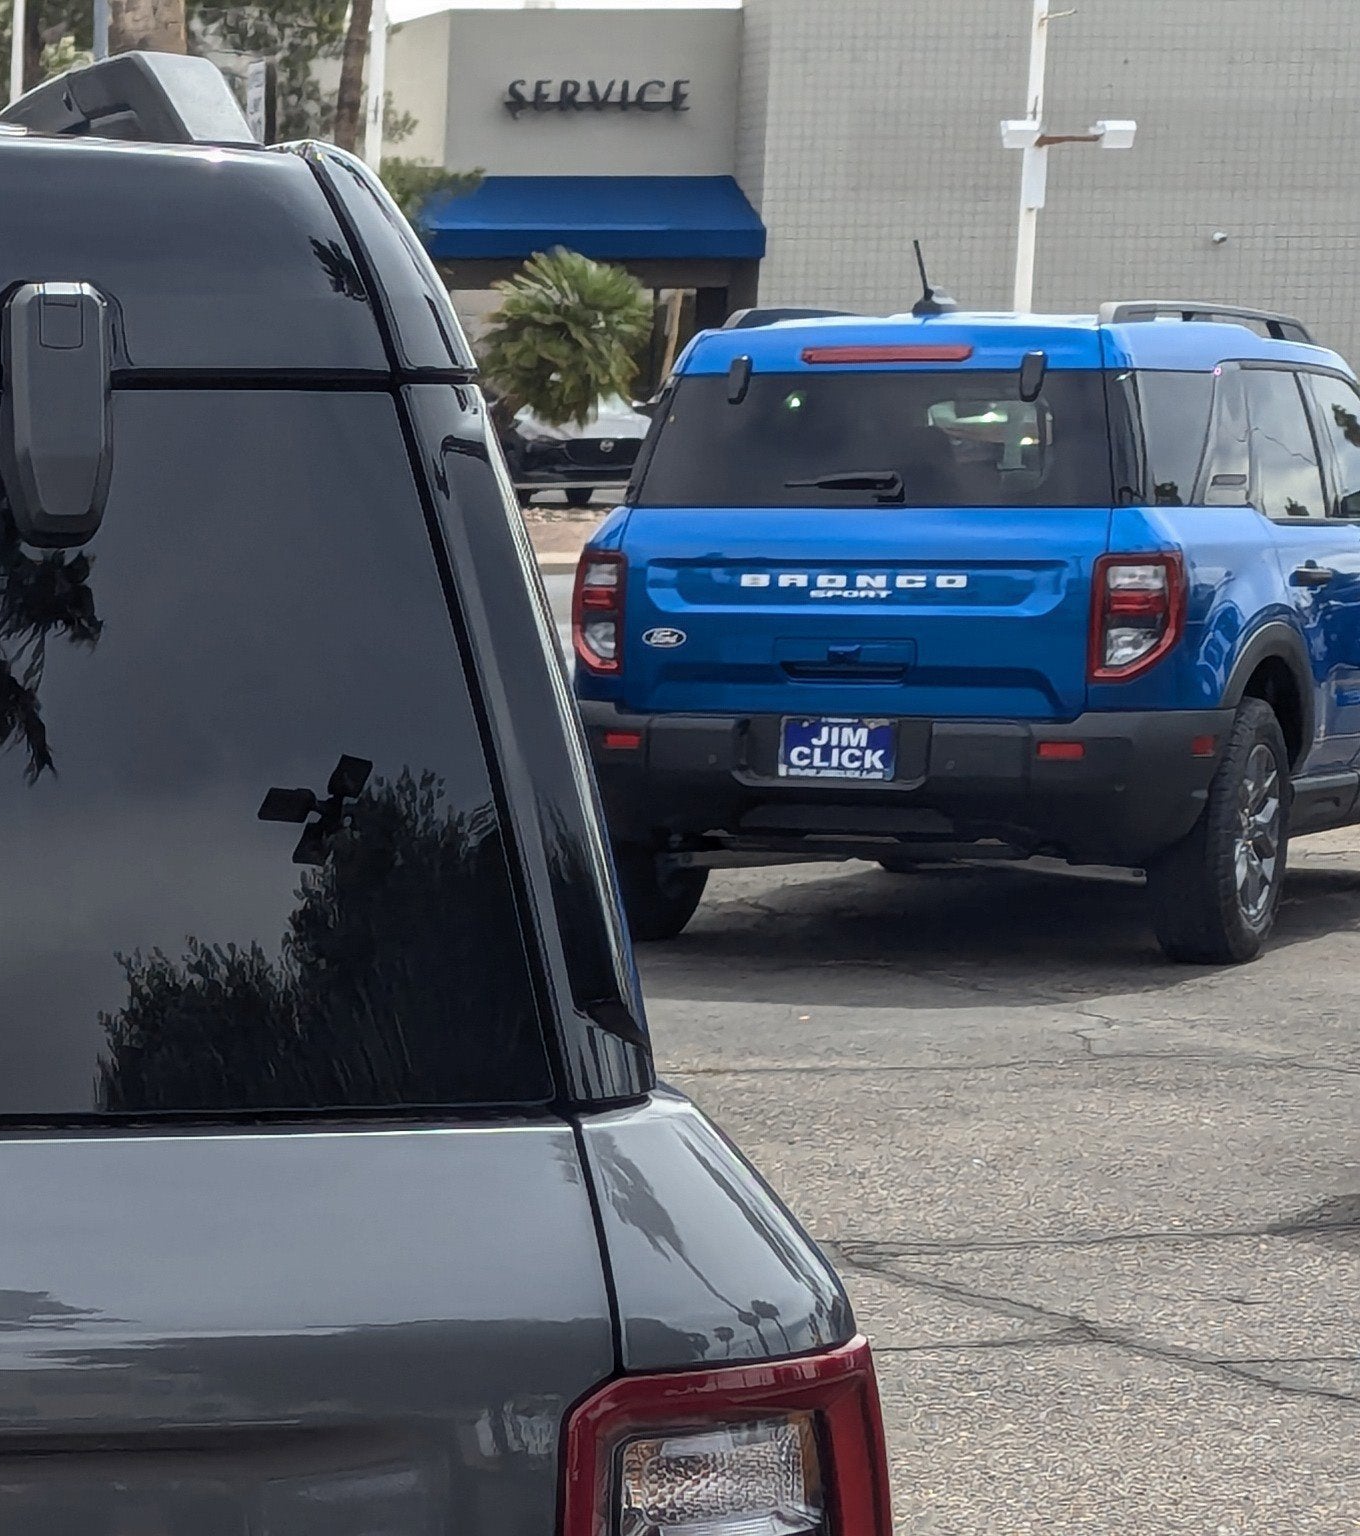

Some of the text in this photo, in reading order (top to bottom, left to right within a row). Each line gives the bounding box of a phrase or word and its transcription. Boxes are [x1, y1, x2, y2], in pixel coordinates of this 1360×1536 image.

[505, 79, 690, 112] SERVICE
[740, 573, 968, 589] BRONCO
[809, 589, 892, 599] SPORT
[811, 726, 868, 747] JIM
[789, 746, 885, 769] CLICK
